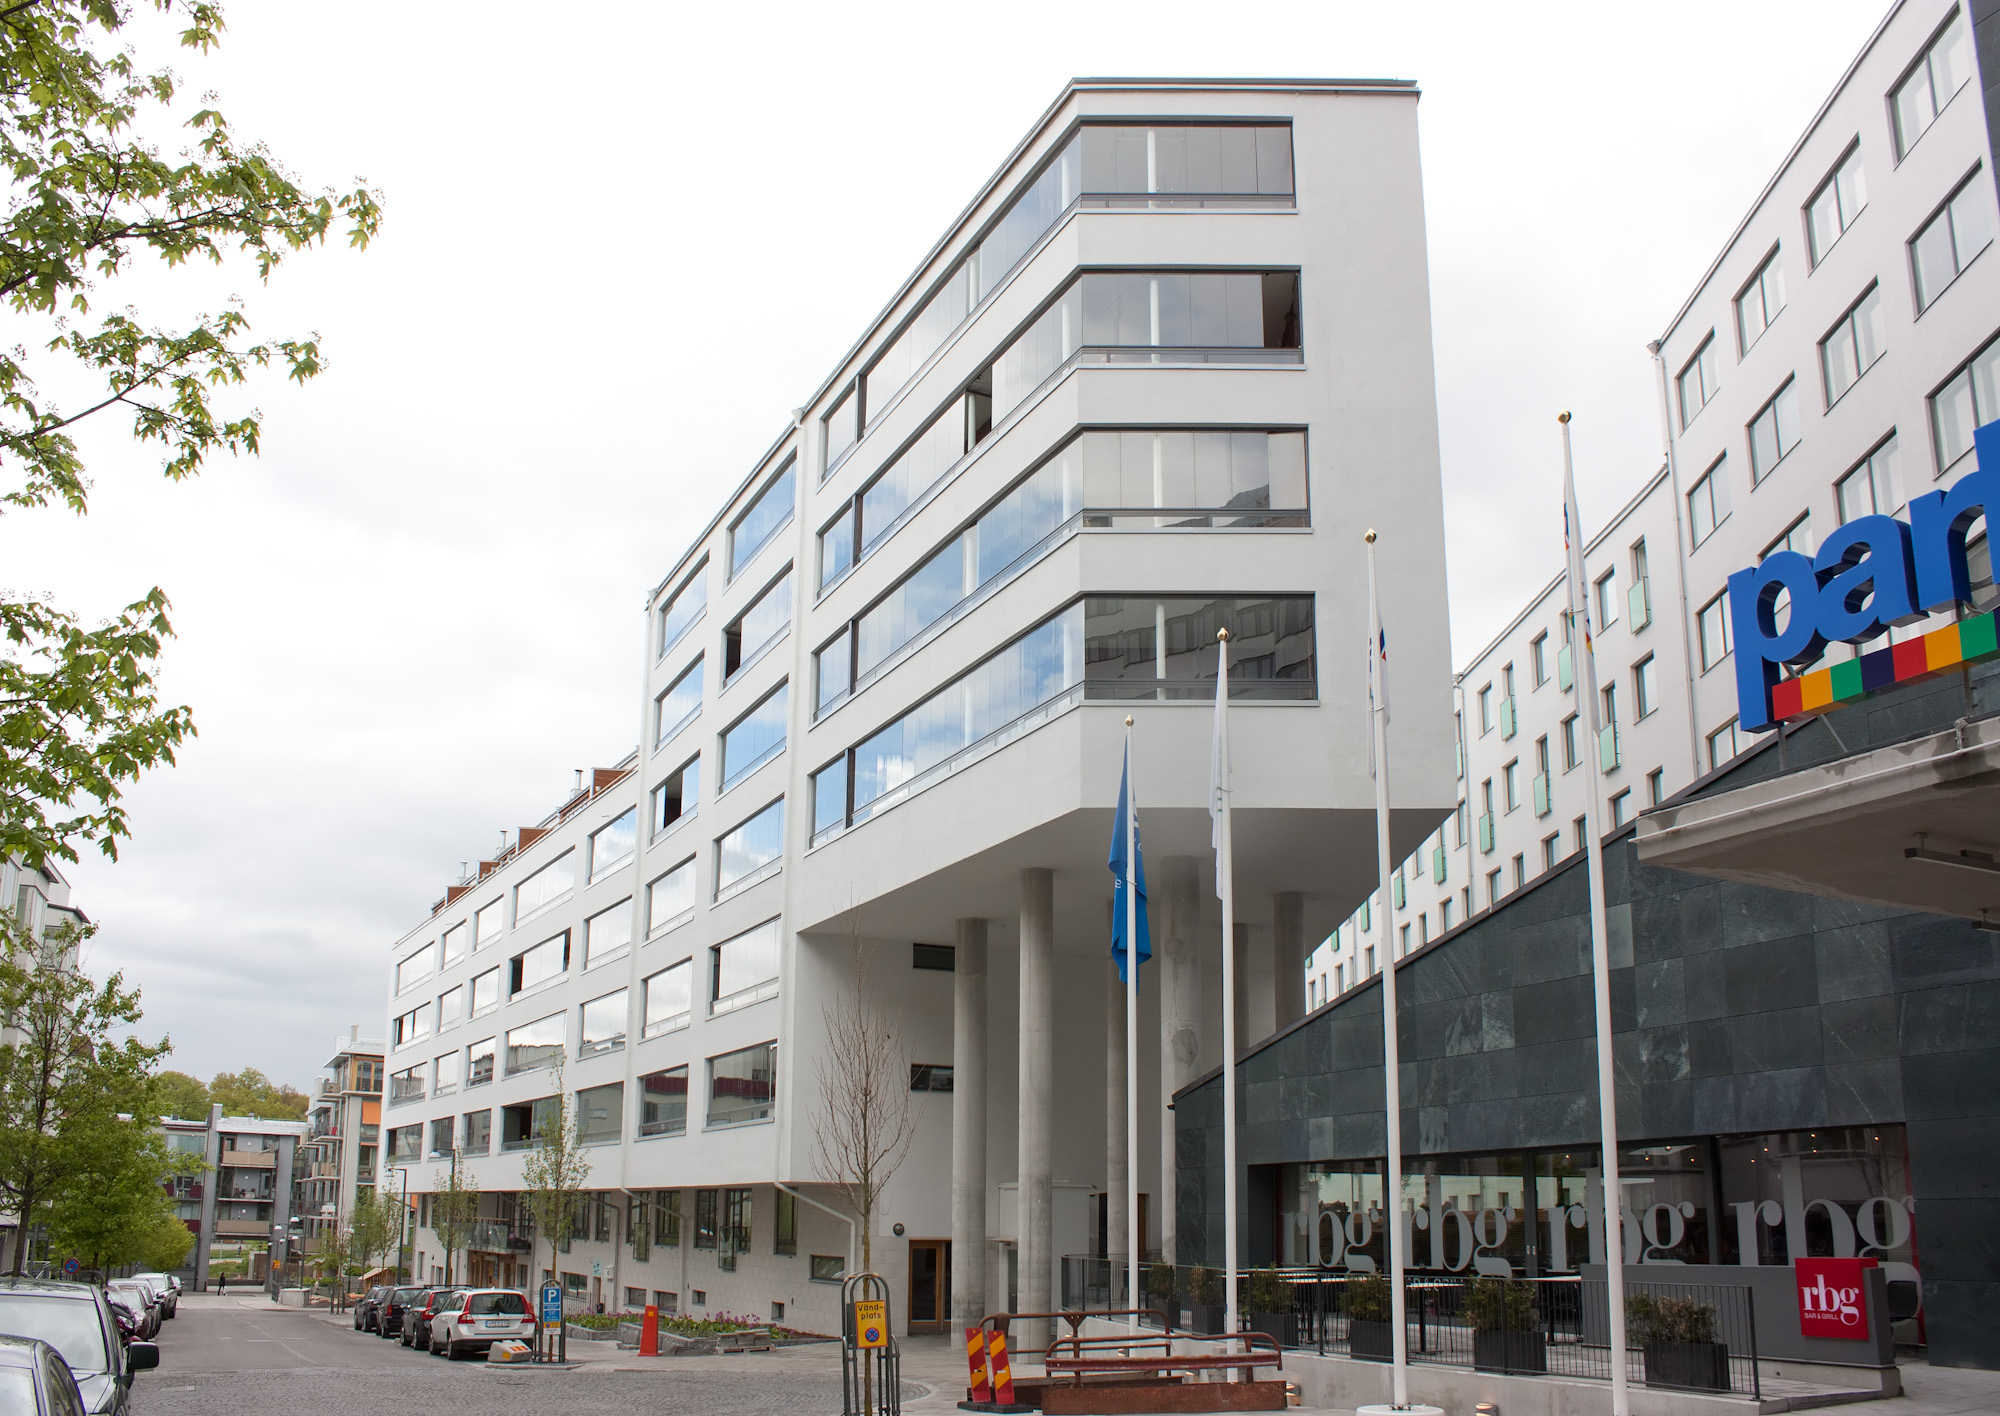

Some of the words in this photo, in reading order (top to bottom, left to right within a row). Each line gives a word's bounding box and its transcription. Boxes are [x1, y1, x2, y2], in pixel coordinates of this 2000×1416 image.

[1282, 1180, 1379, 1276] rbg
[1401, 1175, 1516, 1279] rbg
[1729, 1158, 1923, 1317] rbg
[547, 1289, 557, 1302] P
[857, 1303, 884, 1312] Vänd-
[860, 1312, 882, 1321] plats
[1801, 1274, 1860, 1326] rbg
